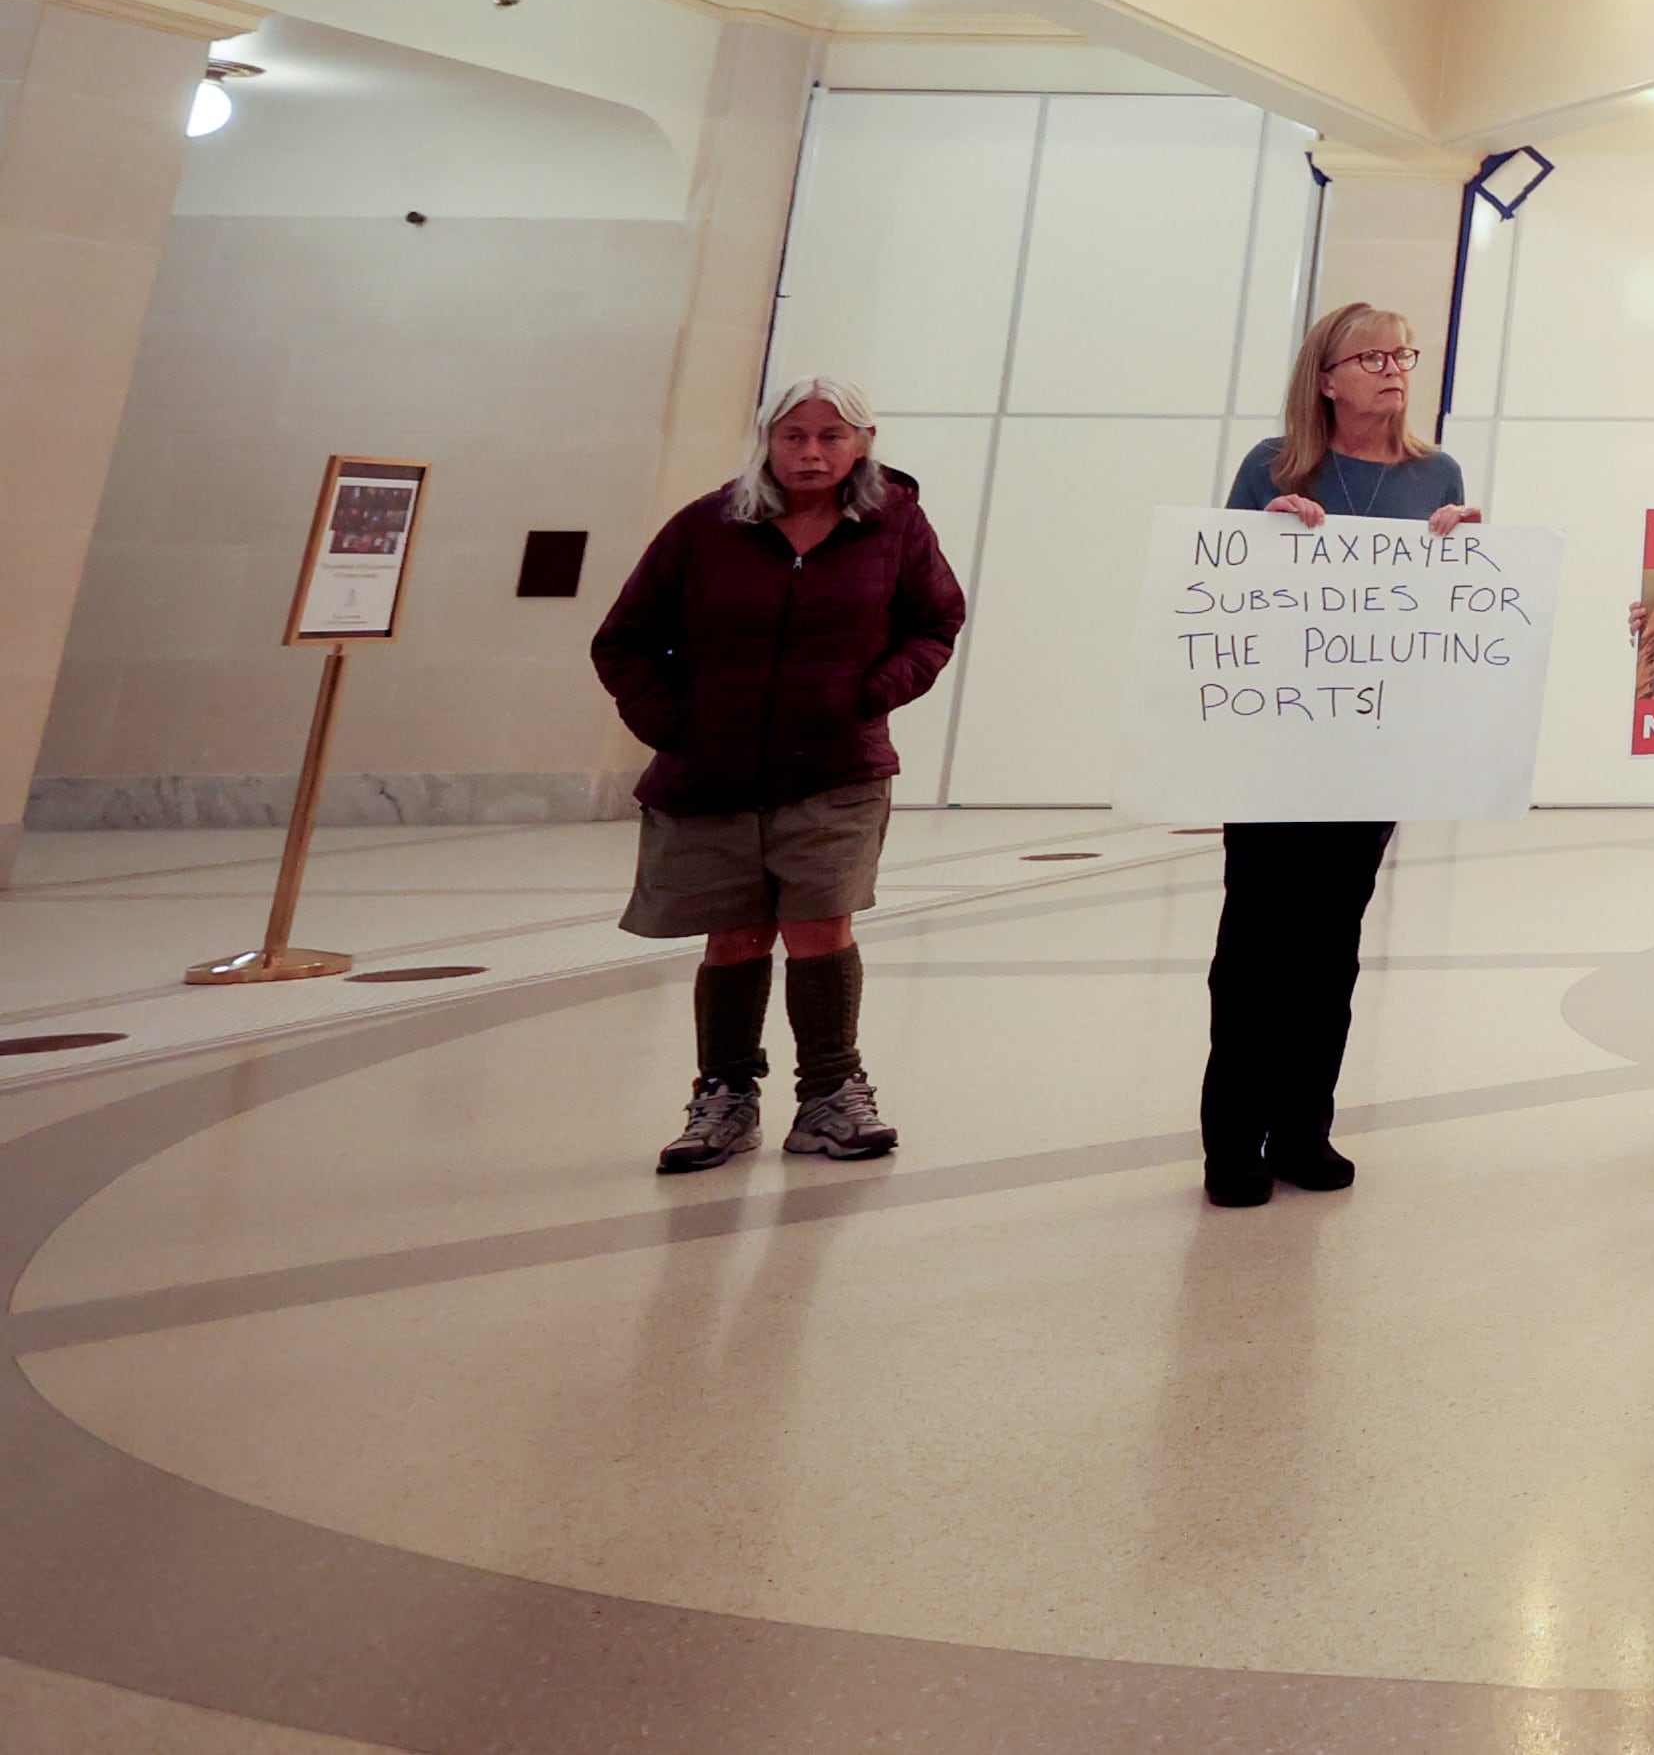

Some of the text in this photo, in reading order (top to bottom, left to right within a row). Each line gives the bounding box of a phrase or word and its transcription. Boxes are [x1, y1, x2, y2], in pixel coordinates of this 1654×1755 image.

[1195, 530, 1501, 572] NO TAXPAYER
[1175, 582, 1531, 625] SUBSIDIES FOR
[1178, 627, 1510, 669] THE POLLUTING
[1200, 680, 1384, 729] PORTS!
